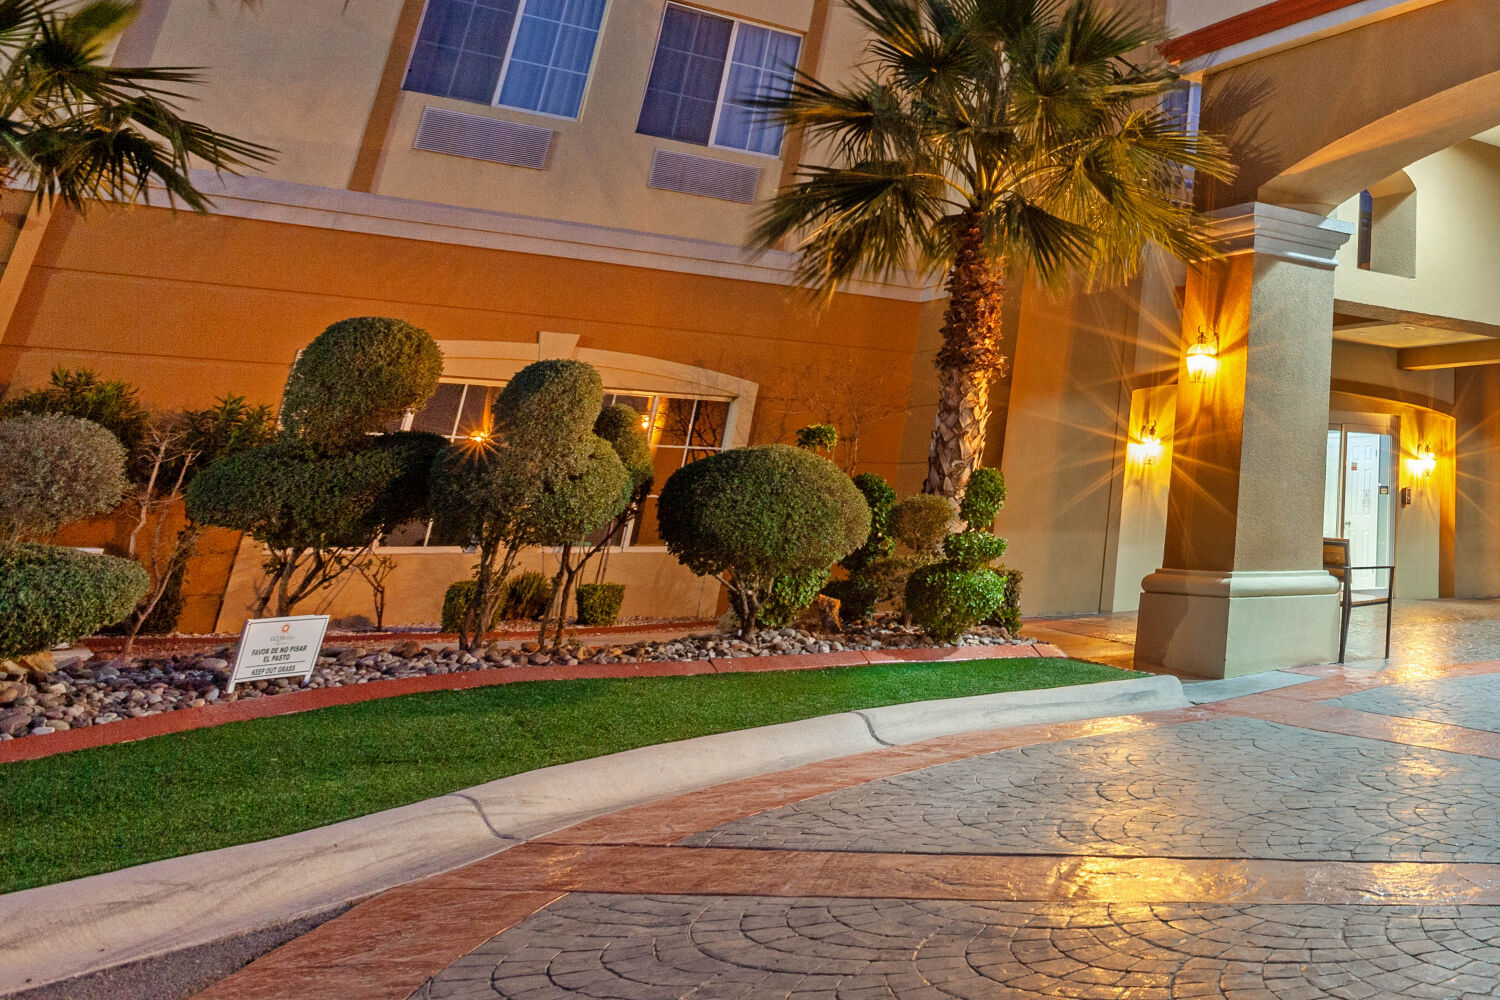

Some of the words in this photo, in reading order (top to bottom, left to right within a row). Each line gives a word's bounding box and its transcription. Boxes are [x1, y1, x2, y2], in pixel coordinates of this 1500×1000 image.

[251, 648, 270, 656] FAVOR
[251, 668, 265, 676] KEEP
[277, 665, 296, 673] GRASS
